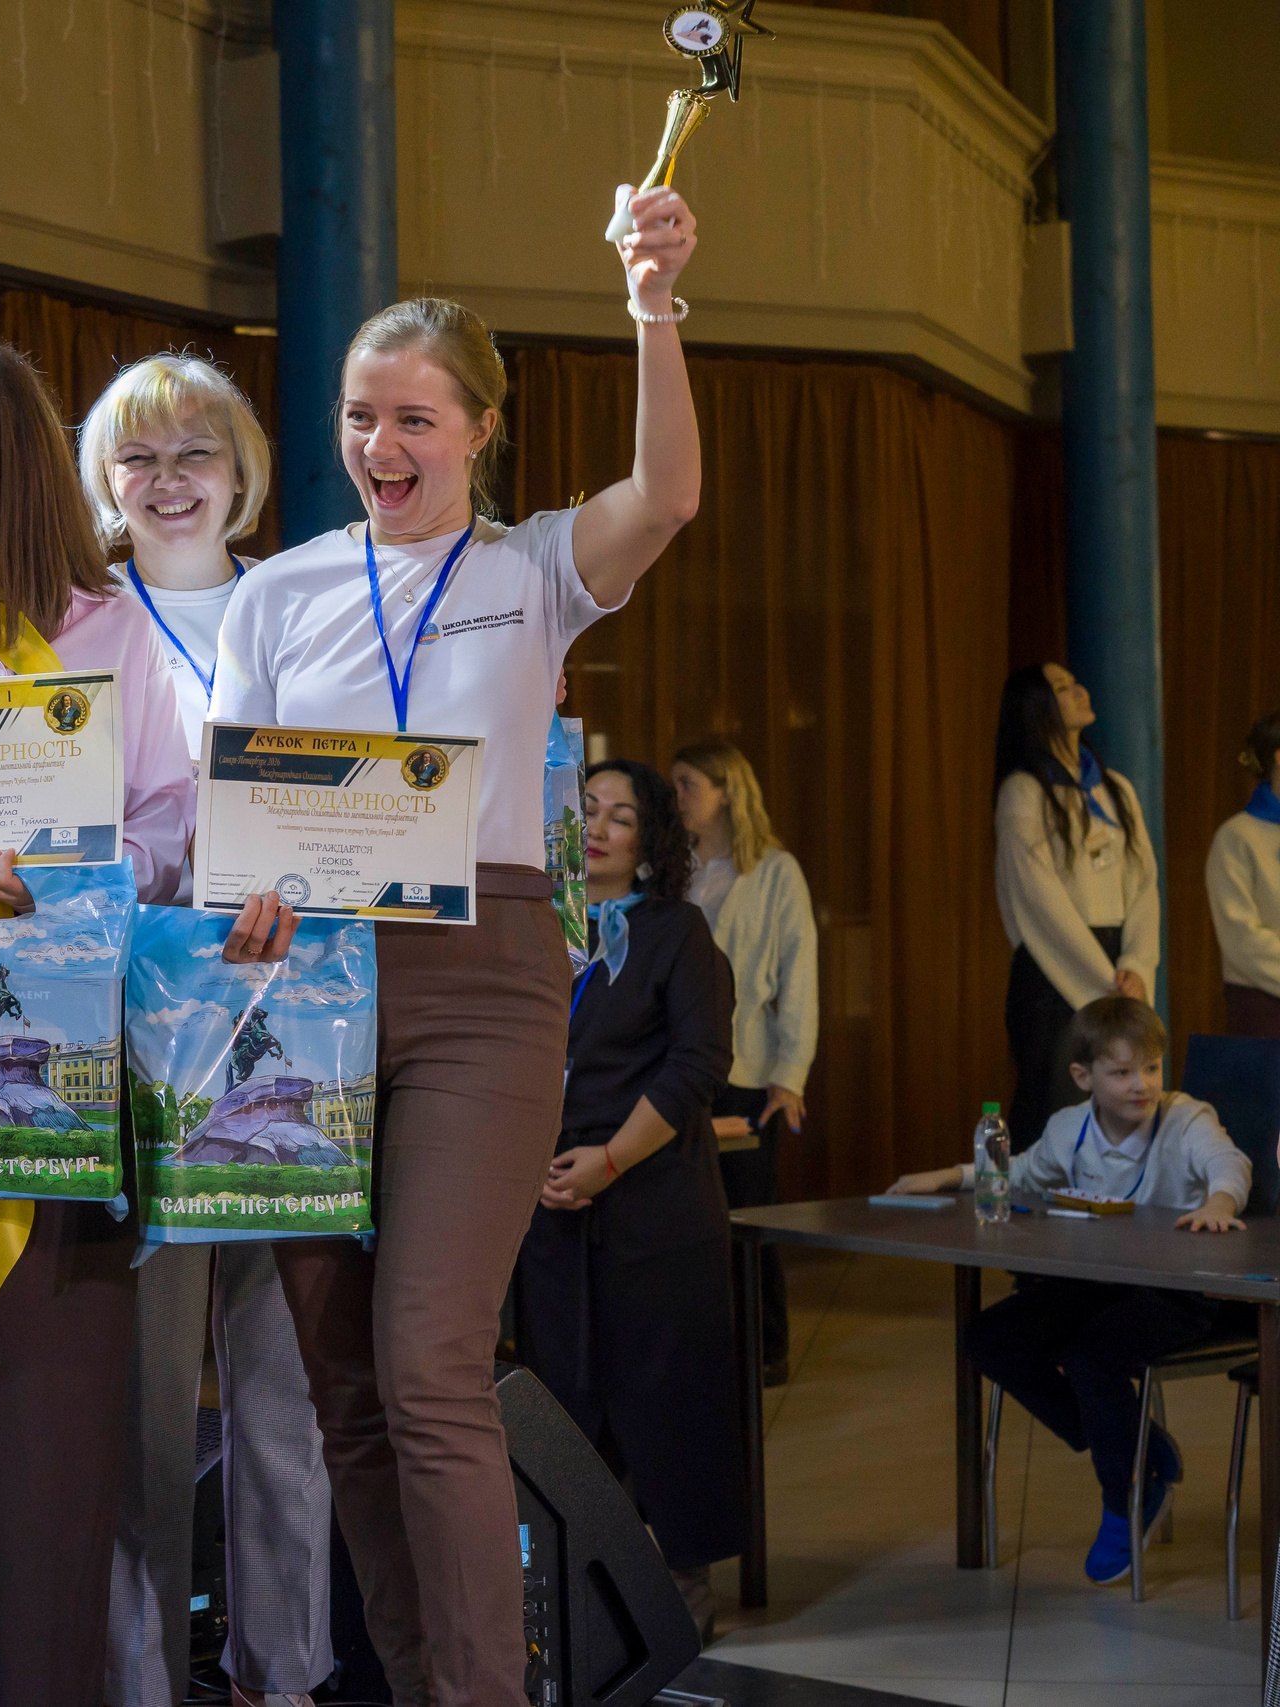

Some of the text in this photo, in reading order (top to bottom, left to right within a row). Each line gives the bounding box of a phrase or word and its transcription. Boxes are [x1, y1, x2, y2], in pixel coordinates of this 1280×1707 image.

[442, 608, 524, 630] ШКОЛА МЕНТАЛЬНОЙ
[7, 690, 12, 702] I
[256, 735, 370, 752] КУБОК ПЕТРА I
[249, 786, 436, 814] БЛАГОДАРНОСТЬ
[21, 817, 59, 827] Туймазы
[298, 842, 373, 854] НАГРАЖДАЕТСЯ
[317, 857, 353, 866] LEOKIDS
[309, 867, 360, 876] г.Ульяновск
[160, 1191, 364, 1215] САНКТ-ПЕТЕРБУРГ
